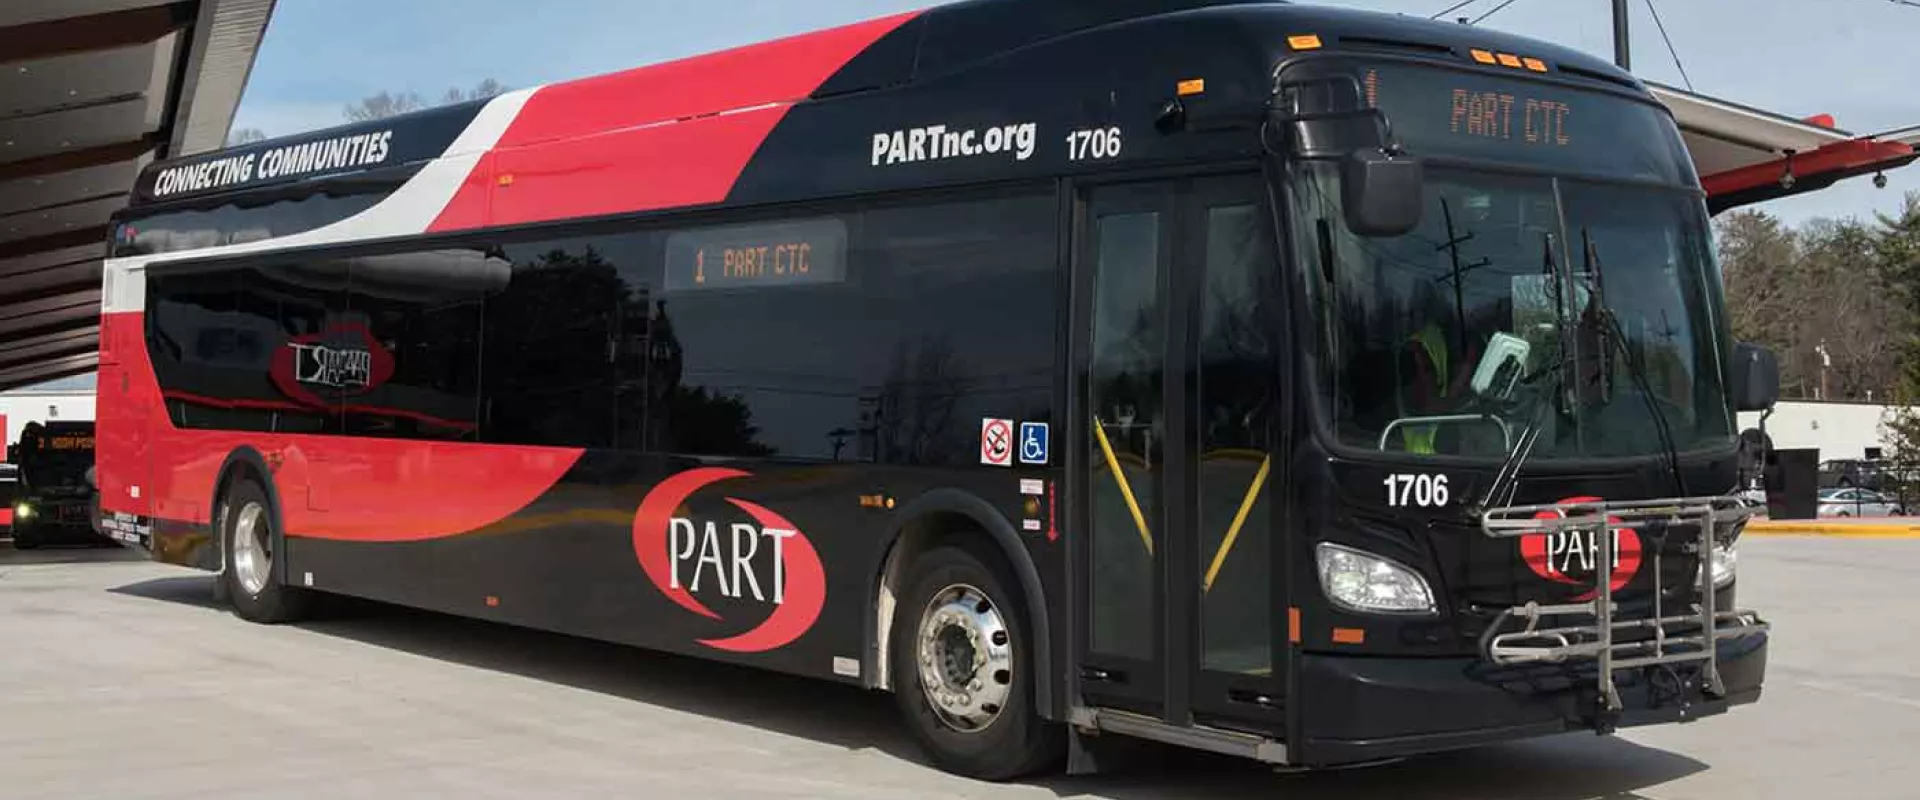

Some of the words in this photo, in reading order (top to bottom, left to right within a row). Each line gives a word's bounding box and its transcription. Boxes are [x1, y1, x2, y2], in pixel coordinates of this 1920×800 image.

[1450, 88, 1515, 139] PART
[1524, 98, 1571, 146] CTC
[153, 153, 255, 197] CONNECTING
[257, 130, 394, 180] COMMUNITIES
[871, 122, 1037, 166] PARTnc.org
[1065, 126, 1122, 161] 1706
[694, 249, 706, 284] 1
[723, 246, 769, 277] PART
[774, 242, 811, 275] CTC
[1383, 473, 1449, 507] 1706
[668, 517, 798, 605] PART
